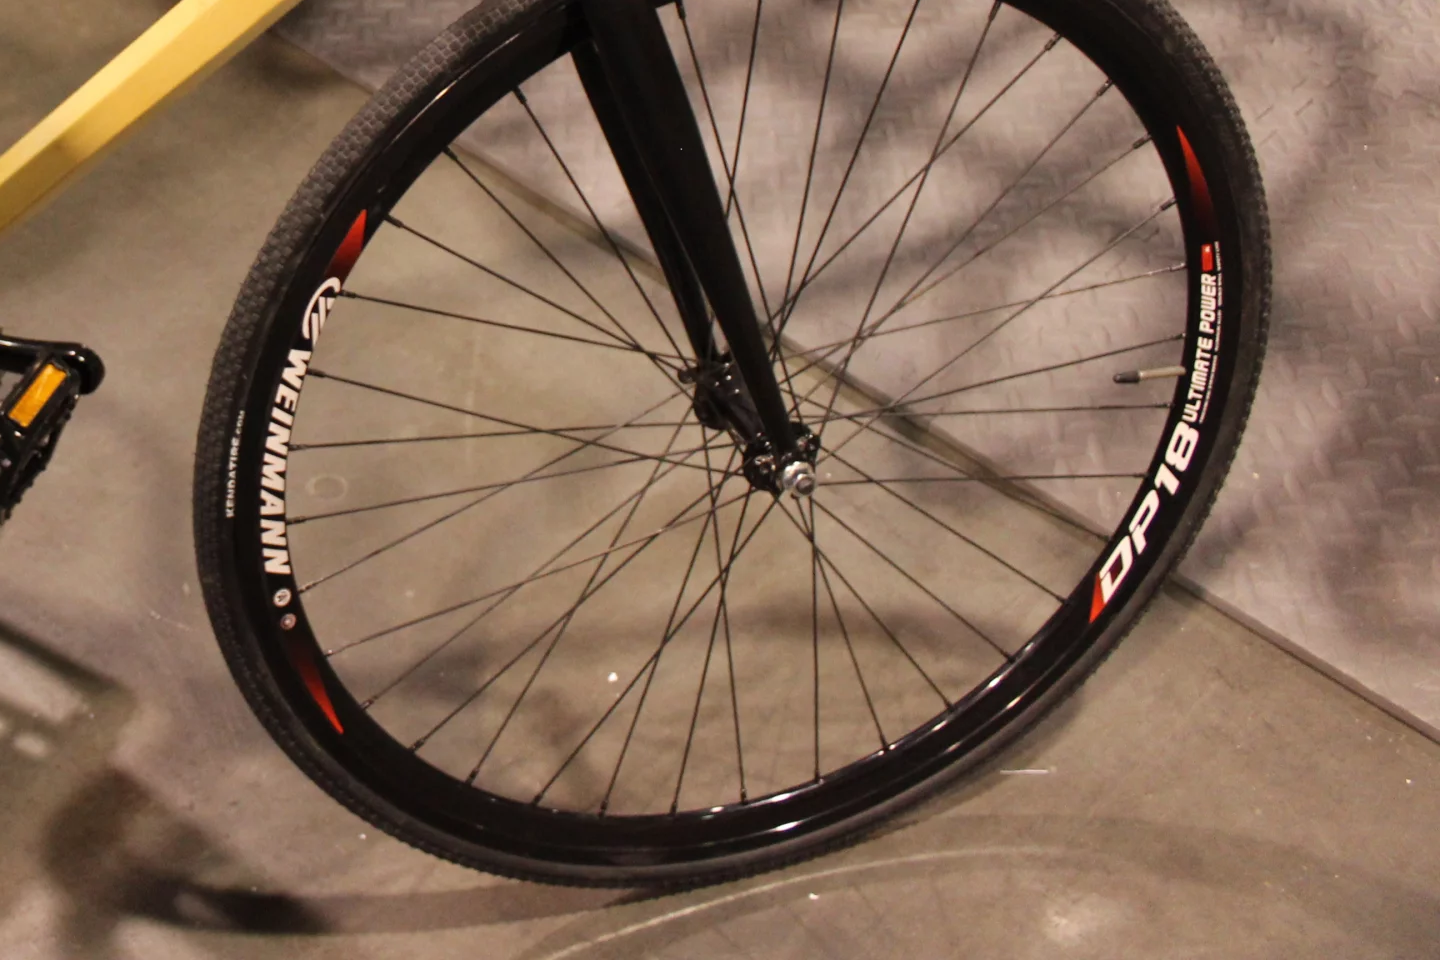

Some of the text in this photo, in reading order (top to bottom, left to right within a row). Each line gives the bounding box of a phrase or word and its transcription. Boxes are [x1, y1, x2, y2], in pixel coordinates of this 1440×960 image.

[260, 349, 313, 575] WEINMANN
[1098, 418, 1200, 606] DP18
[1182, 336, 1213, 423] ULTIMATE
[1199, 273, 1216, 334] POWER
